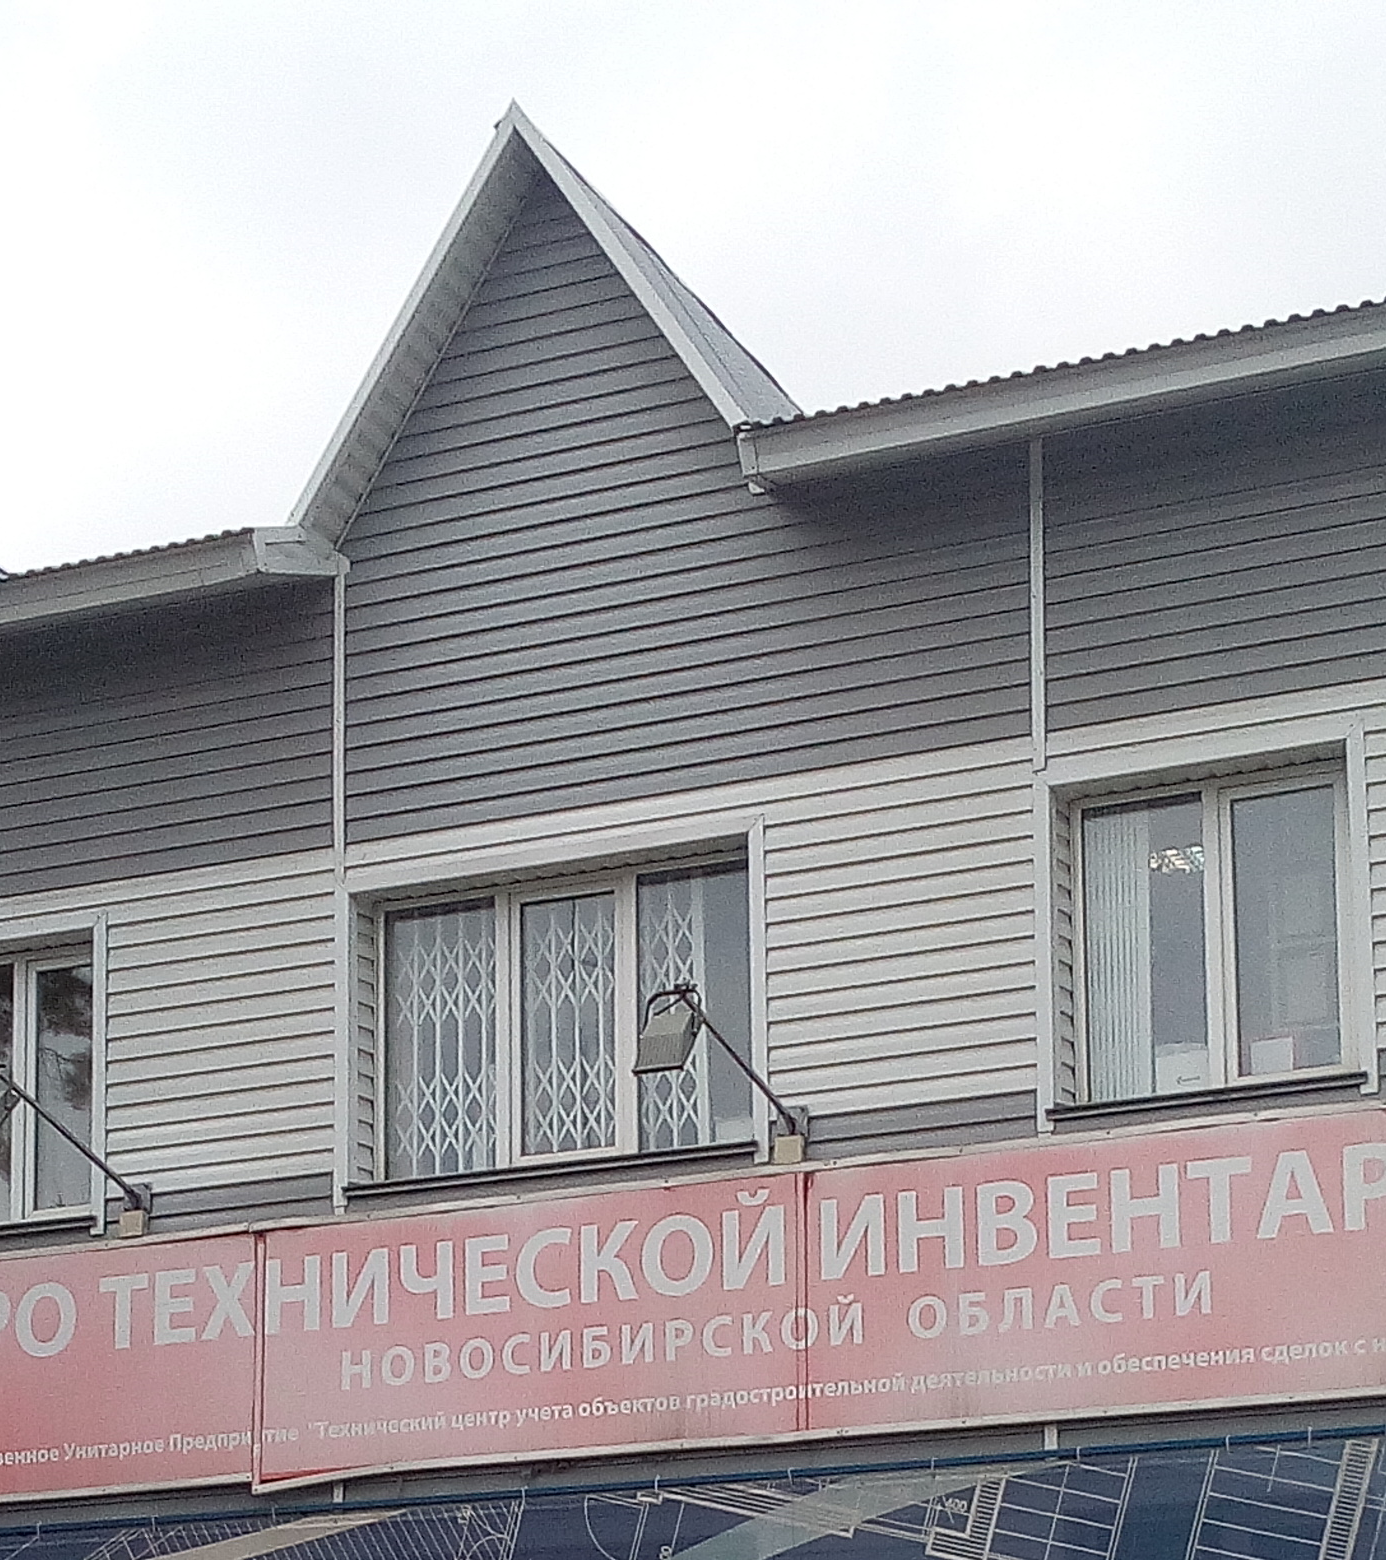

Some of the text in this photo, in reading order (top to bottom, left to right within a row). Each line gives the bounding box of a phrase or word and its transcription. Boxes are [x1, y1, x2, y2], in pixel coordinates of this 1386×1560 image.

[99, 1188, 788, 1350] ТЕХНИЧЕСКОЙ
[341, 1270, 1213, 1391] НОВОСИБИРСКОЙ ОБЛАСТИ
[63, 1439, 165, 1462] Унитарное
[169, 1427, 300, 1454] Предпритие
[515, 1403, 573, 1427] учета
[579, 1394, 681, 1416] объектов
[686, 1373, 906, 1409] градостроительной
[911, 1361, 1071, 1393] деятельности
[1077, 1361, 1093, 1378] и
[1097, 1347, 1255, 1374] обеспечения
[1261, 1339, 1348, 1364] сделок
[1353, 1338, 1366, 1354] с
